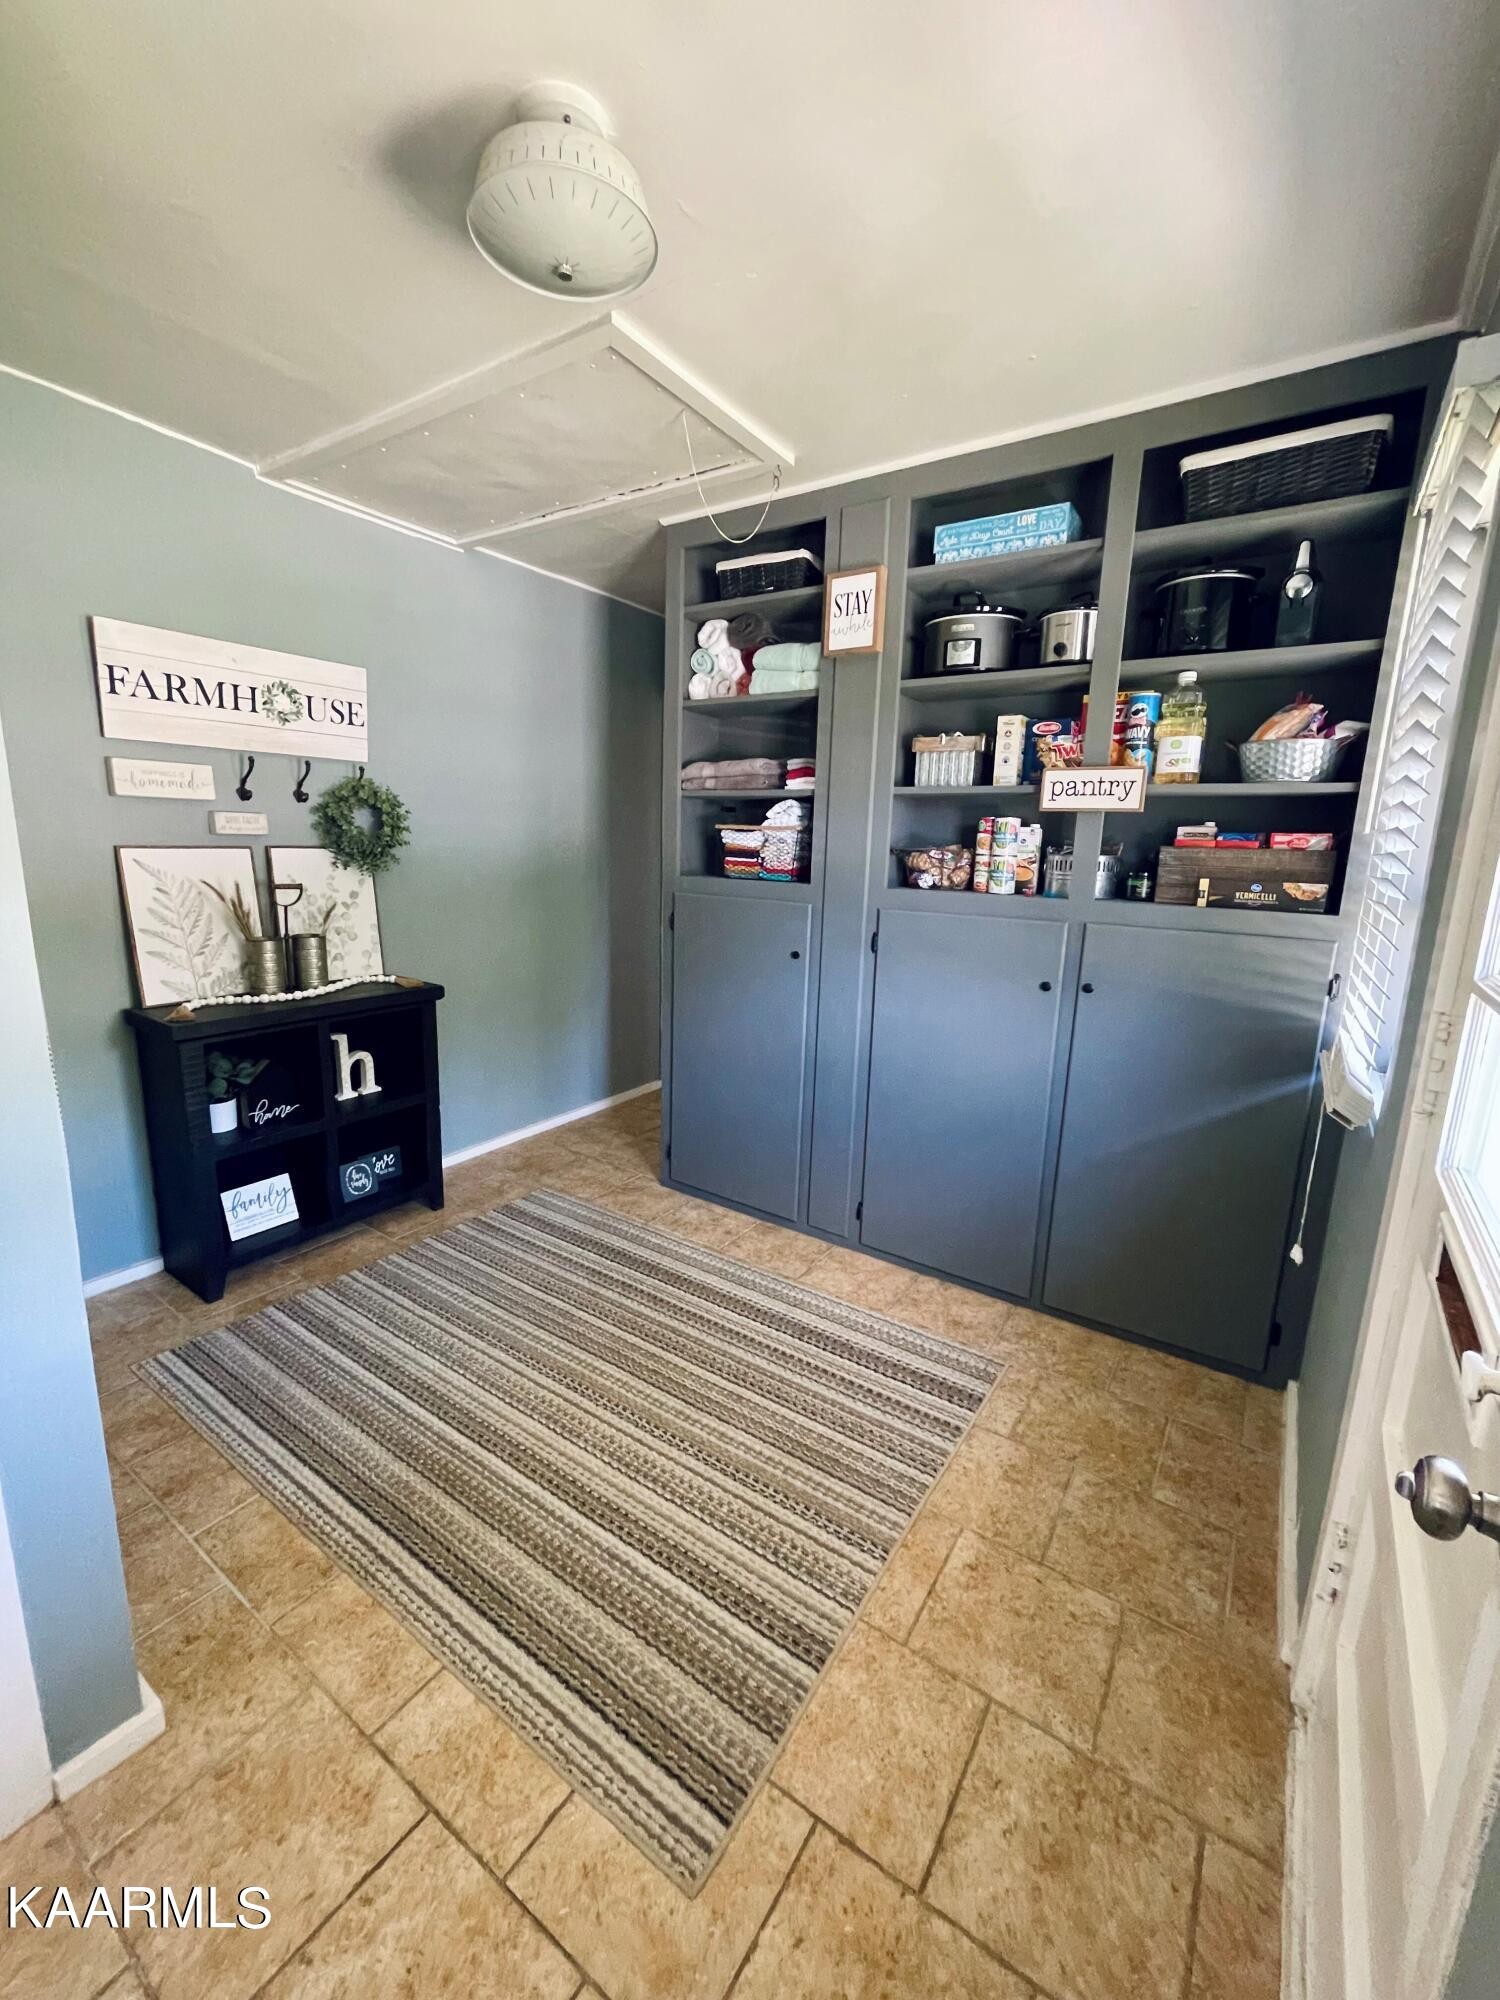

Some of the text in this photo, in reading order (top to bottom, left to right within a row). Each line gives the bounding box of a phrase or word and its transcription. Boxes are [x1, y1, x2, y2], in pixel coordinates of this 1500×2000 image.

[1016, 512, 1037, 527] LOVE
[1039, 518, 1063, 531] DAY
[833, 588, 873, 618] STAY
[1048, 776, 1137, 802] pantry
[1235, 891, 1277, 901] VERMICELLI
[330, 1033, 383, 1101] h
[248, 1099, 300, 1125] home
[224, 1182, 292, 1219] family
